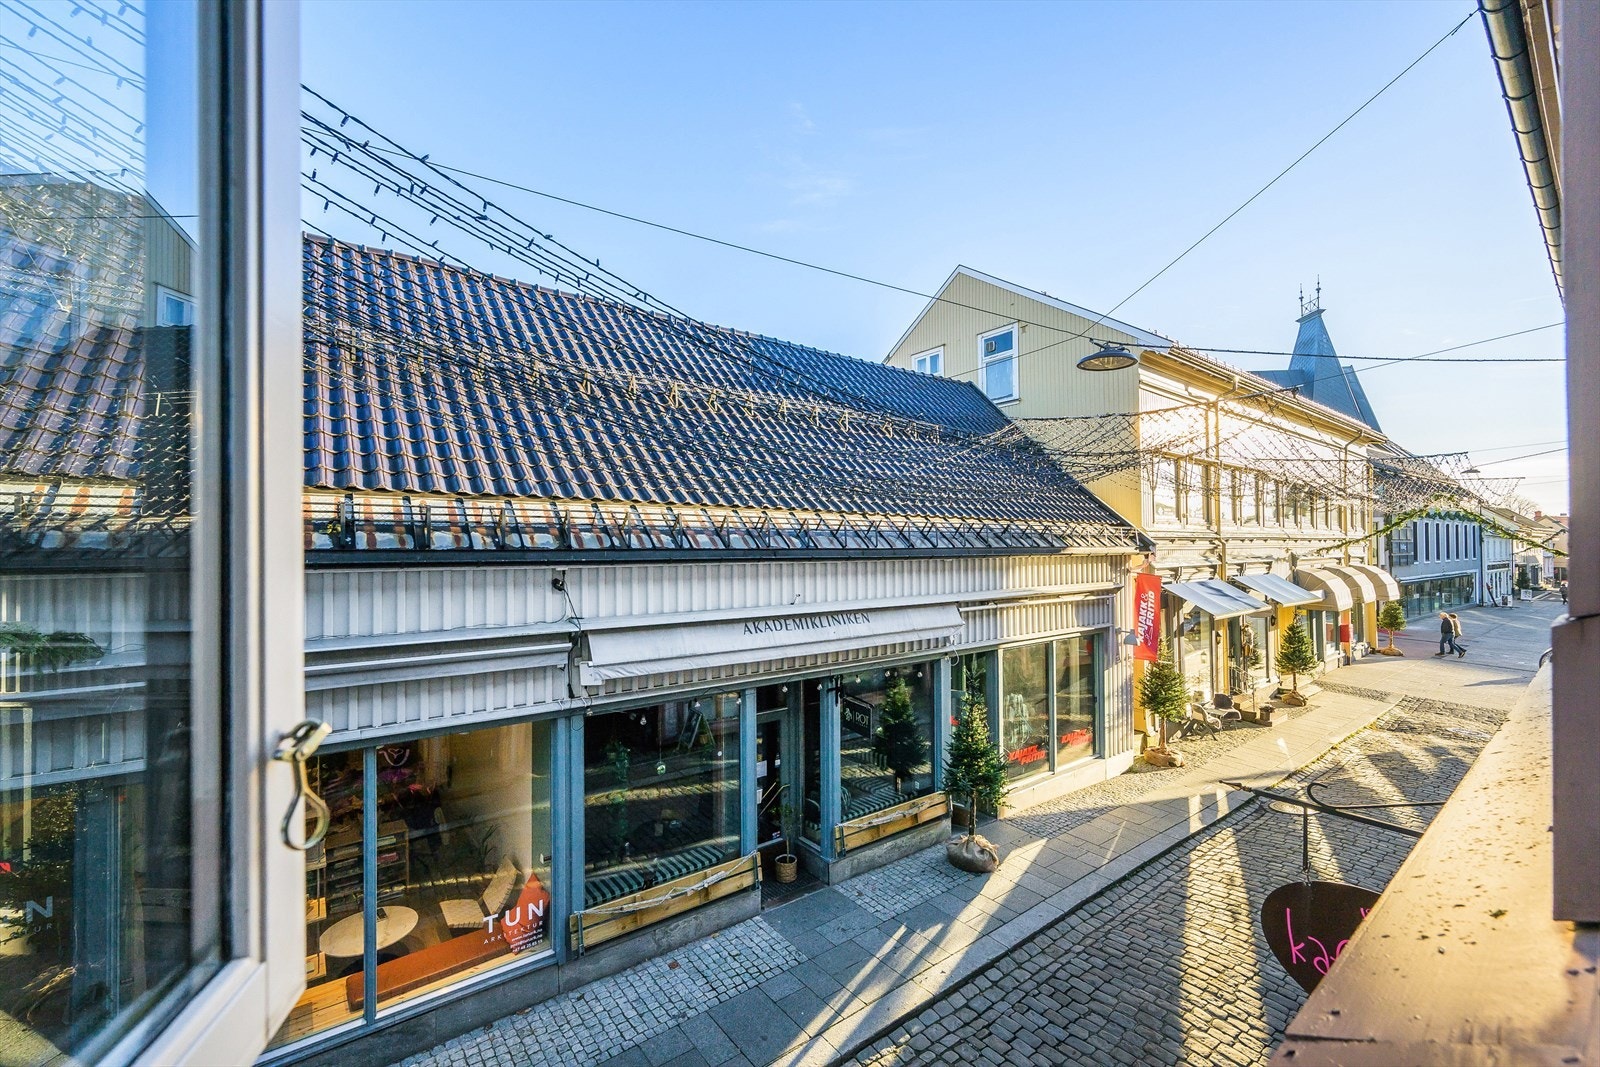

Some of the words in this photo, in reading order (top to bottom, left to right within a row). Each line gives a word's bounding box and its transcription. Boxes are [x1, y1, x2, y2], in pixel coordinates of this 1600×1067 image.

[1146, 591, 1155, 626] FRITID
[743, 612, 871, 635] AKADEMIKLINIKEN
[483, 900, 544, 933] TUN
[483, 920, 544, 945] ARKITEKTUR
